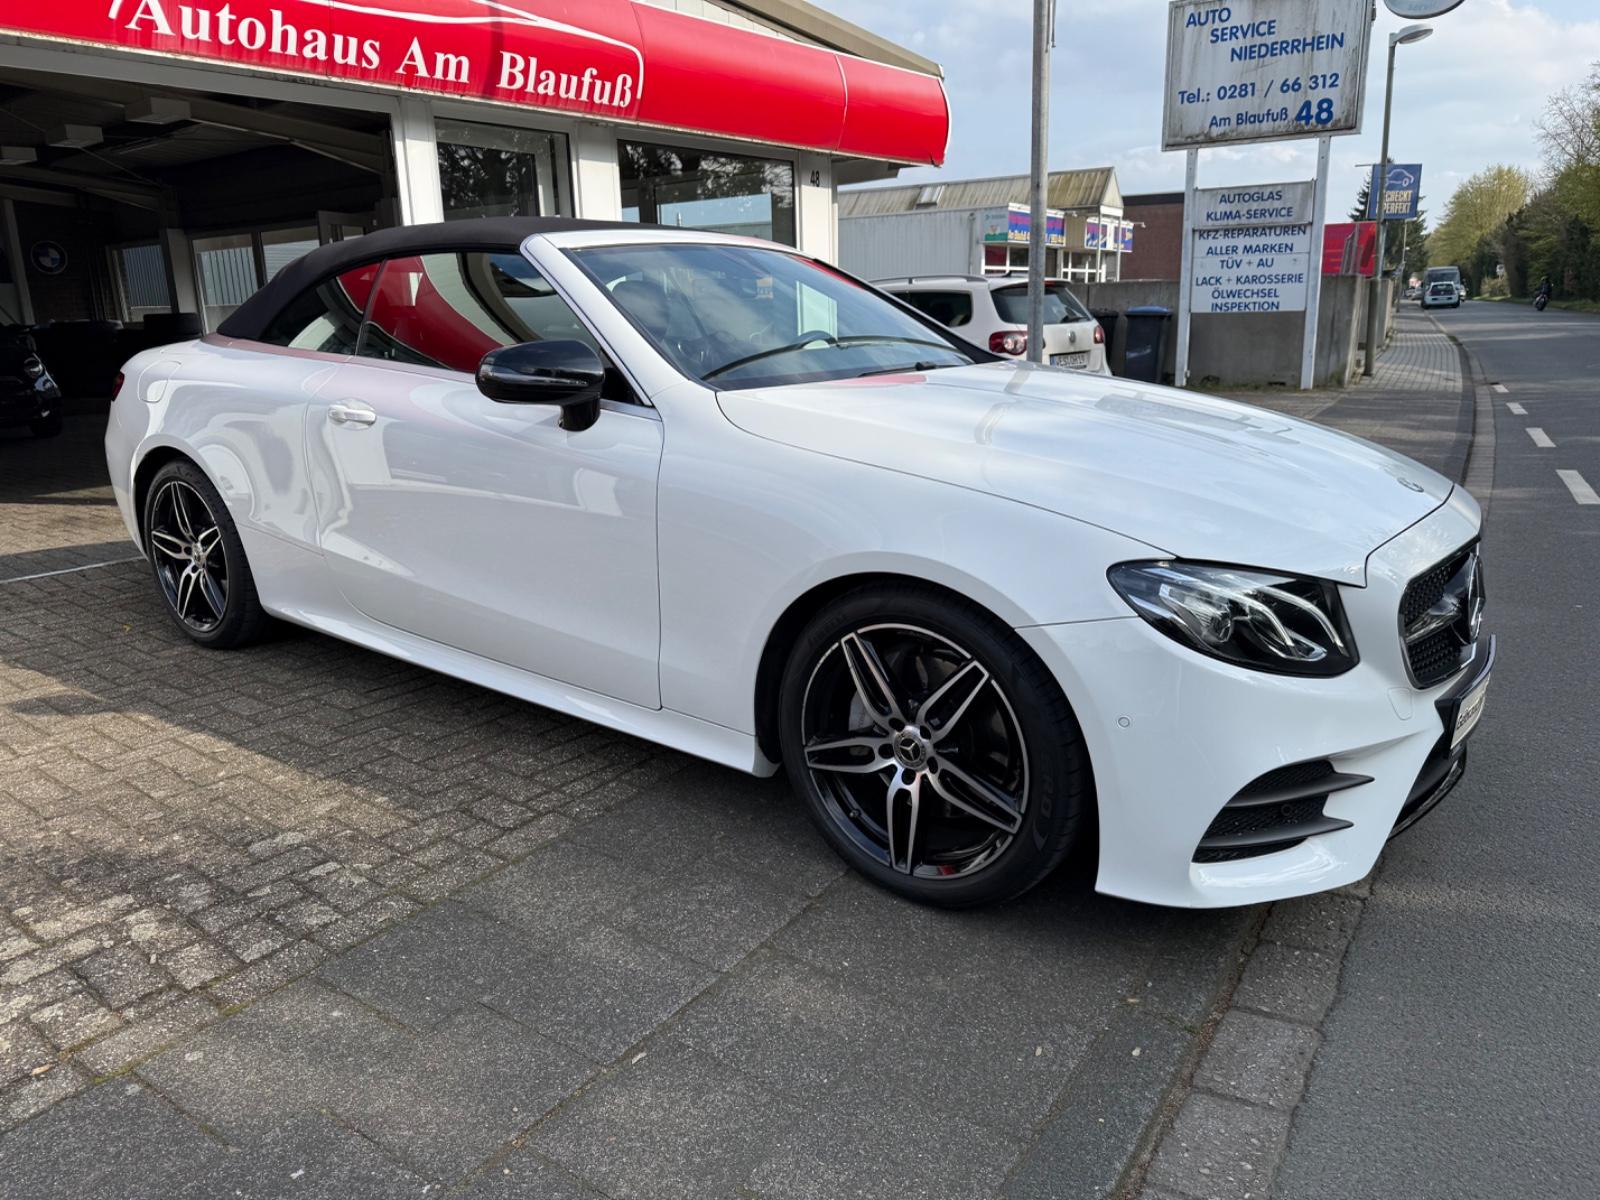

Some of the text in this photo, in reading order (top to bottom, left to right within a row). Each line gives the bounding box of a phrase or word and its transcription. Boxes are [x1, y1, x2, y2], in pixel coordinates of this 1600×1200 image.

[1185, 7, 1231, 28] AUTO
[1210, 20, 1276, 43] SERVICE
[125, 0, 633, 108] Autohaus Am Blaufuß
[1230, 32, 1345, 62] NIEDERRHEIN
[1178, 72, 1340, 105] Tel.: 0281 / 66 312
[1209, 98, 1334, 128] Am Blaufuß 48
[809, 169, 820, 188] 48
[1219, 190, 1283, 204] AUTOGLAS
[1206, 206, 1294, 221] KLIMA-SERVICE
[1199, 225, 1307, 240] KFZ-REPARATUREN
[1206, 242, 1294, 256] ALLER MARKEN
[1220, 256, 1243, 269] TÜV
[1257, 257, 1275, 268] AU
[1195, 276, 1223, 286] LACK
[1236, 273, 1304, 285] KAROSSERIE
[1212, 287, 1280, 299] ÖLWECHSEL
[1211, 301, 1280, 312] INSPEKTION
